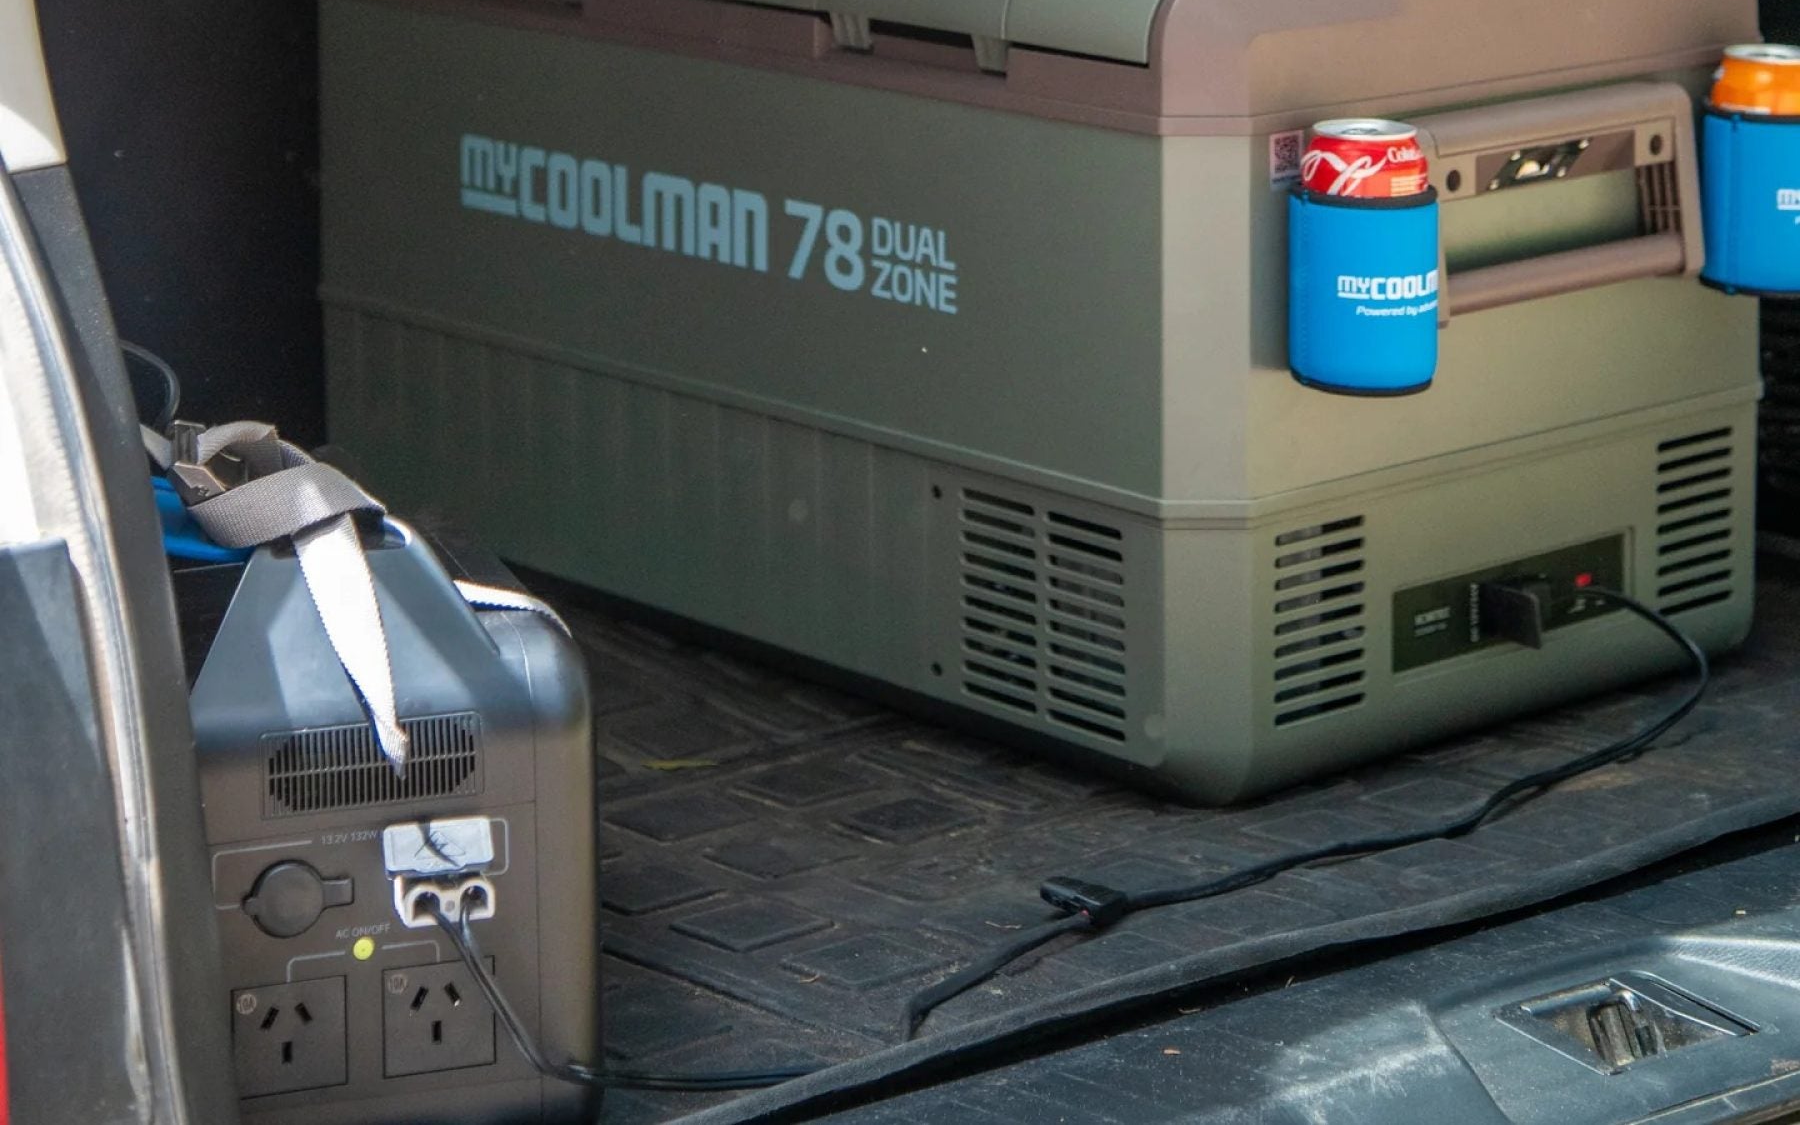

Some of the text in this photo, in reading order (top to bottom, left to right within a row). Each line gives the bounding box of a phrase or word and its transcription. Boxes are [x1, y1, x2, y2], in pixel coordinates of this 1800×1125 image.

[461, 134, 865, 291] MYCOOLMAN 78
[872, 217, 956, 270] DUAL
[871, 261, 957, 314] ZONE
